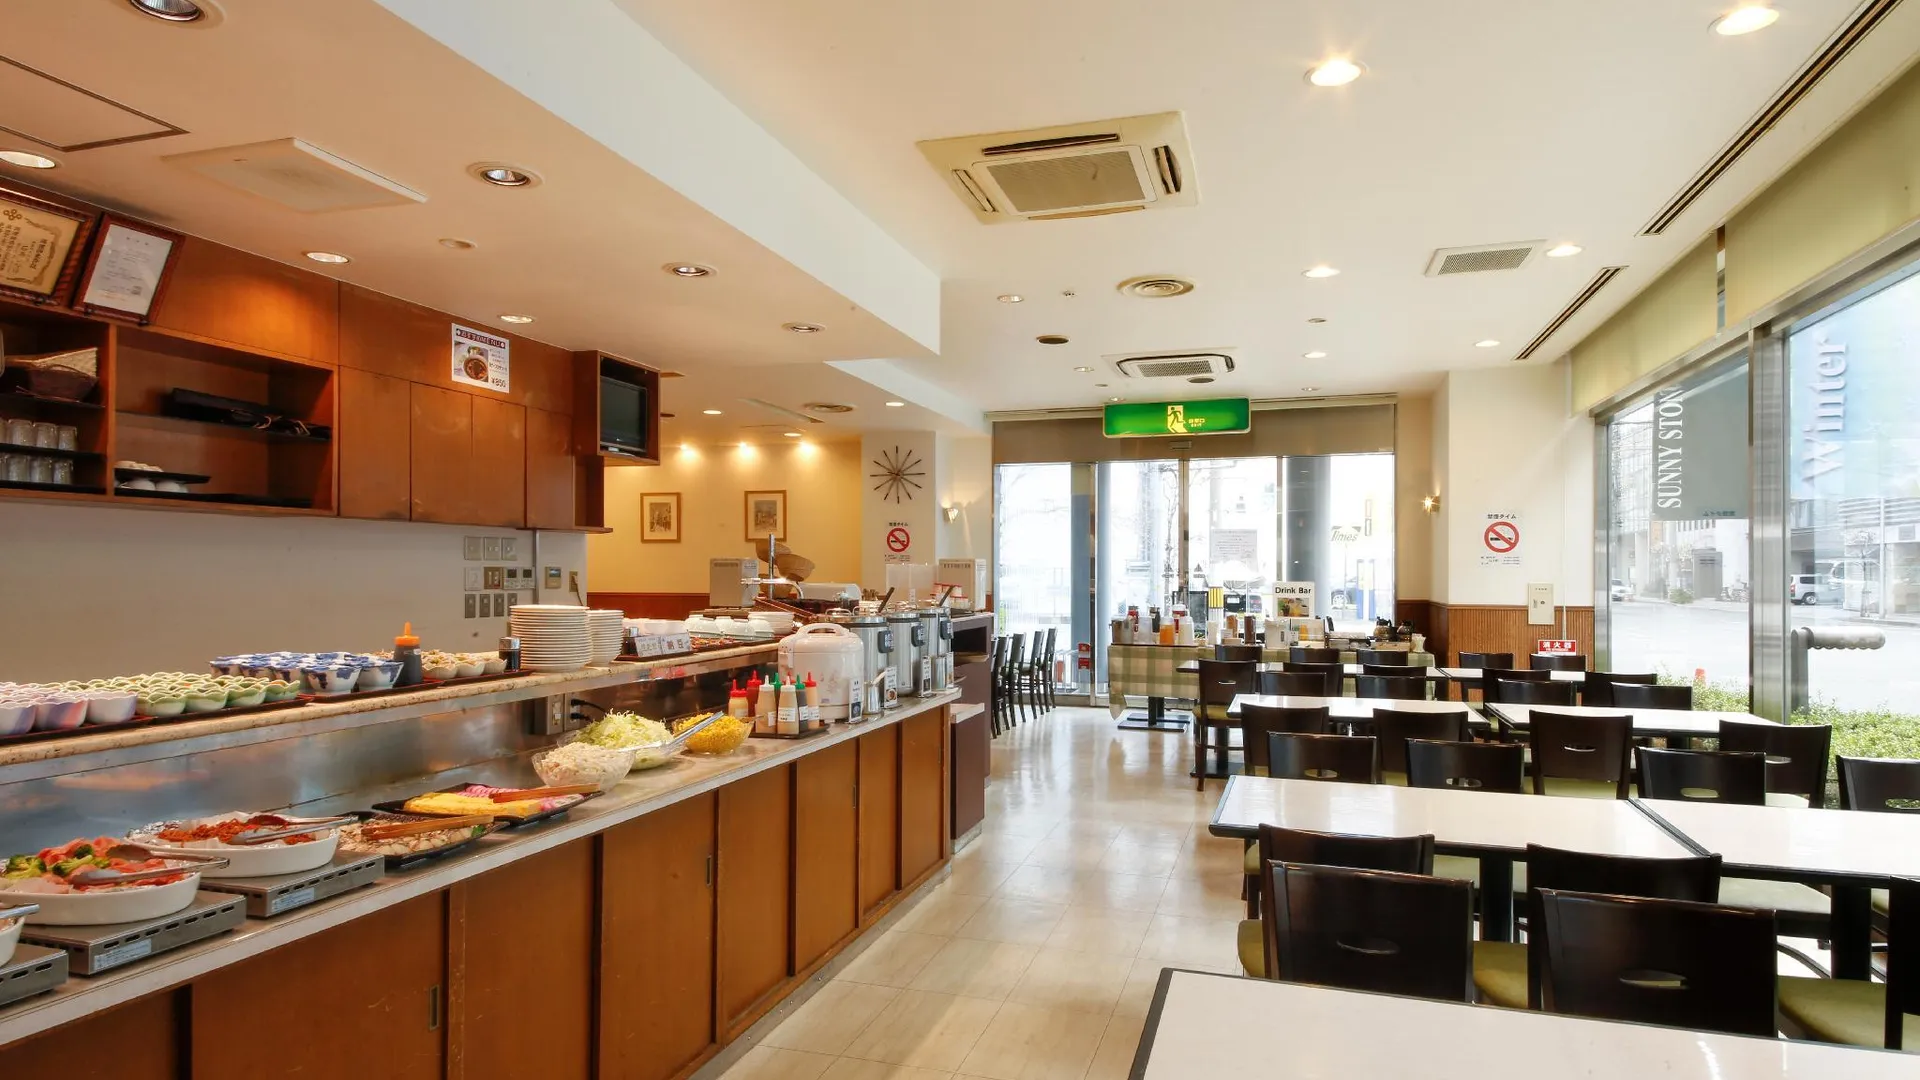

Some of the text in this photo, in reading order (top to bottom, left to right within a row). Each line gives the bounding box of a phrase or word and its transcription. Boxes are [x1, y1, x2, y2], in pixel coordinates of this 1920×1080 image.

[1801, 335, 1847, 483] Winter
[1657, 445, 1682, 509] SUNNY
[1331, 530, 1358, 542] Times
[1275, 586, 1296, 594] Drink
